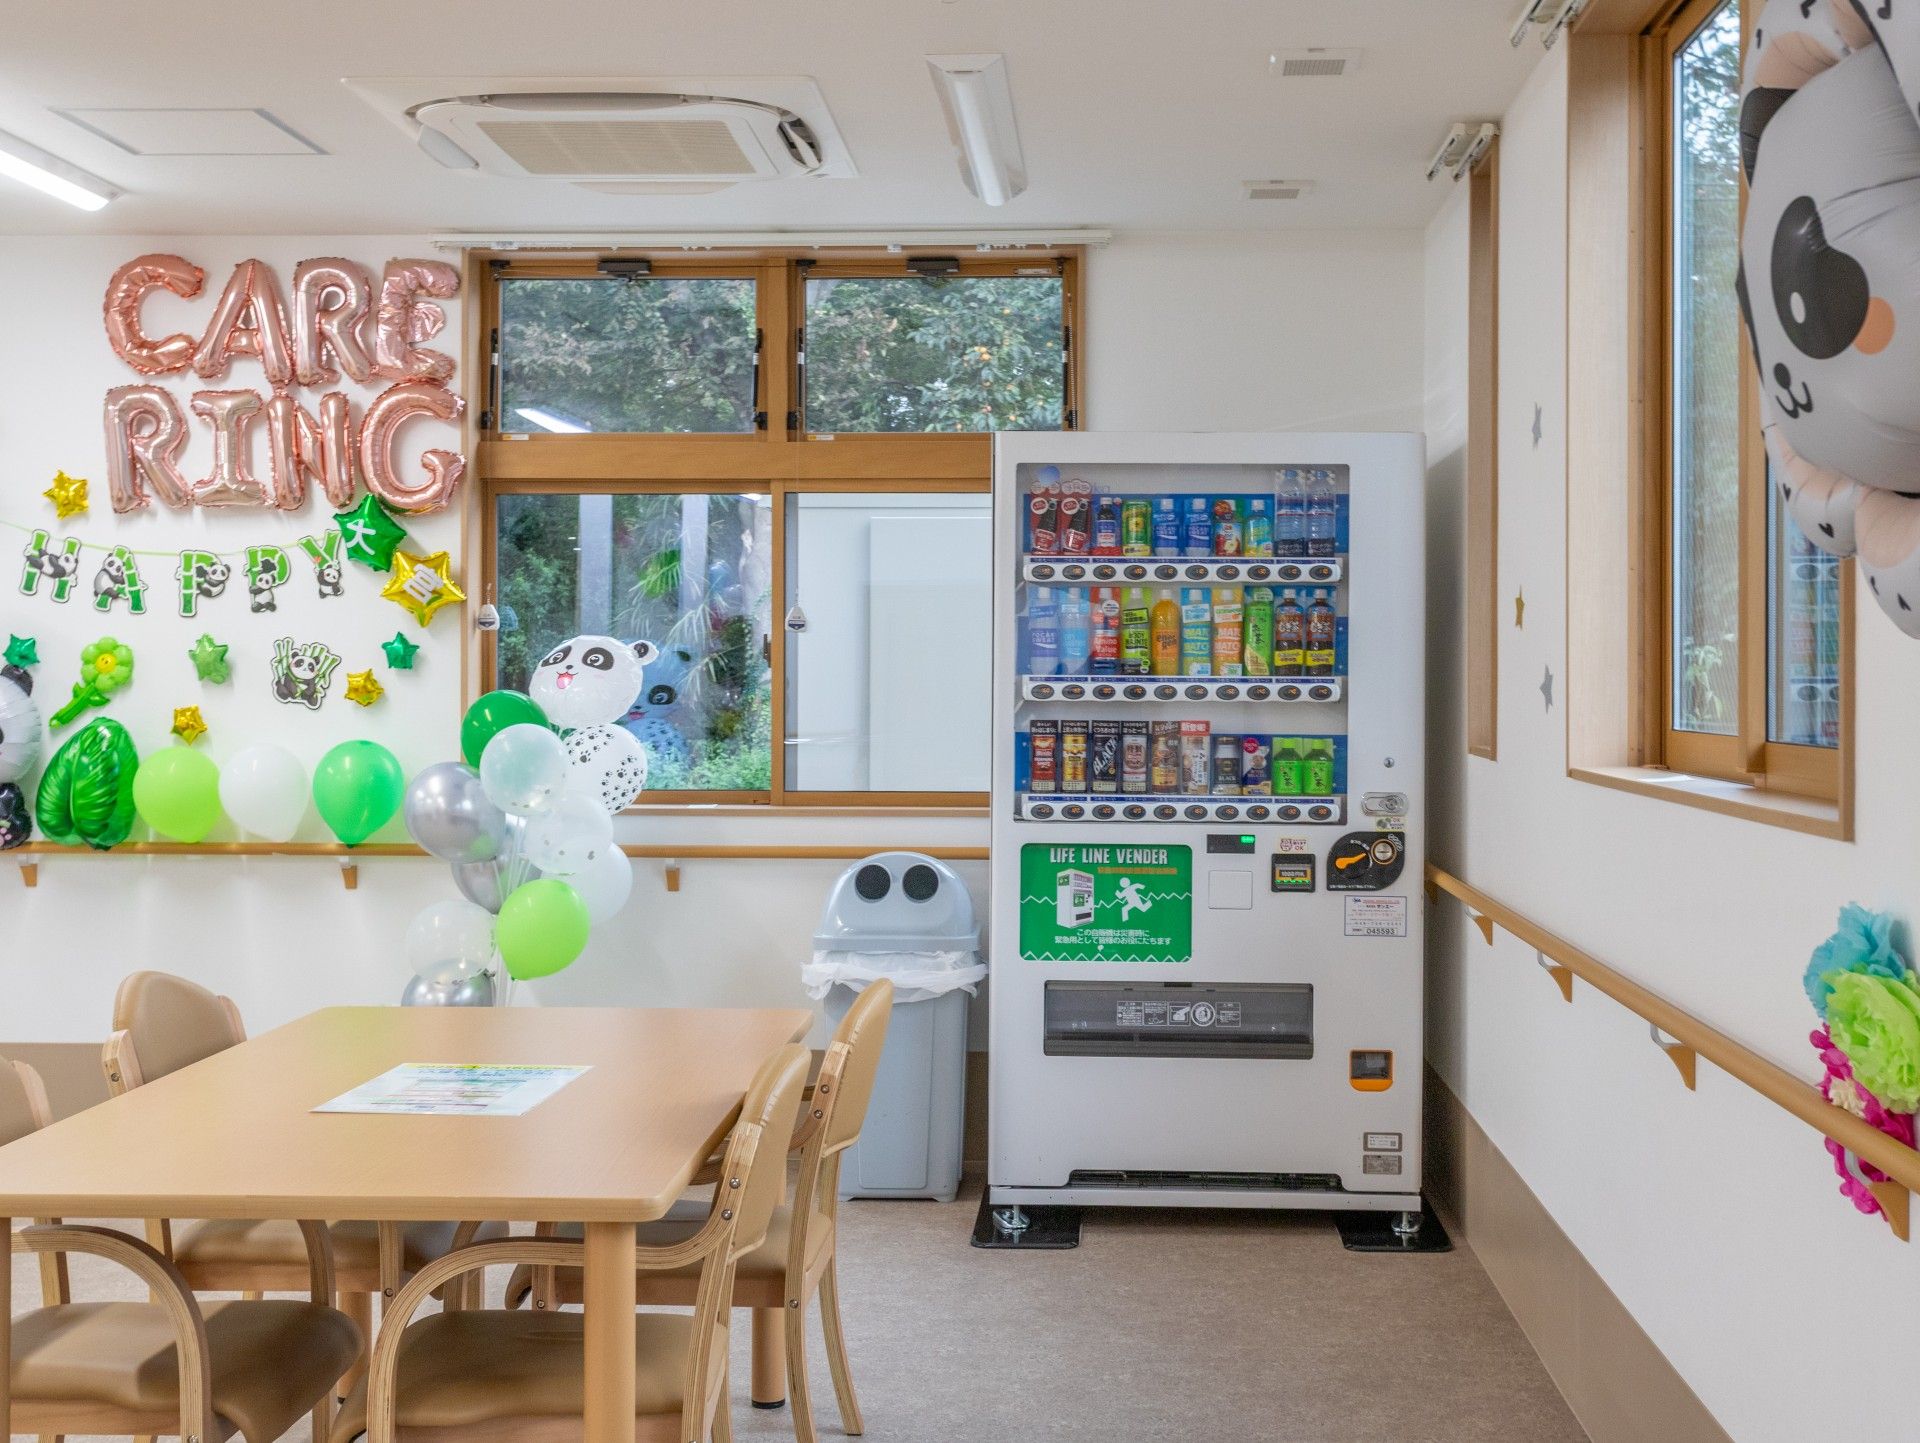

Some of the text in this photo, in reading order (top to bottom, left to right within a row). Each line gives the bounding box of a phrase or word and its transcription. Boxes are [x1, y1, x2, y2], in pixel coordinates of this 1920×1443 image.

[103, 254, 461, 386] CARE
[104, 377, 466, 515] RING
[20, 529, 345, 617] HAPPY
[1092, 737, 1118, 776] BLACK
[1050, 848, 1168, 864] LIFE LINE VENDER
